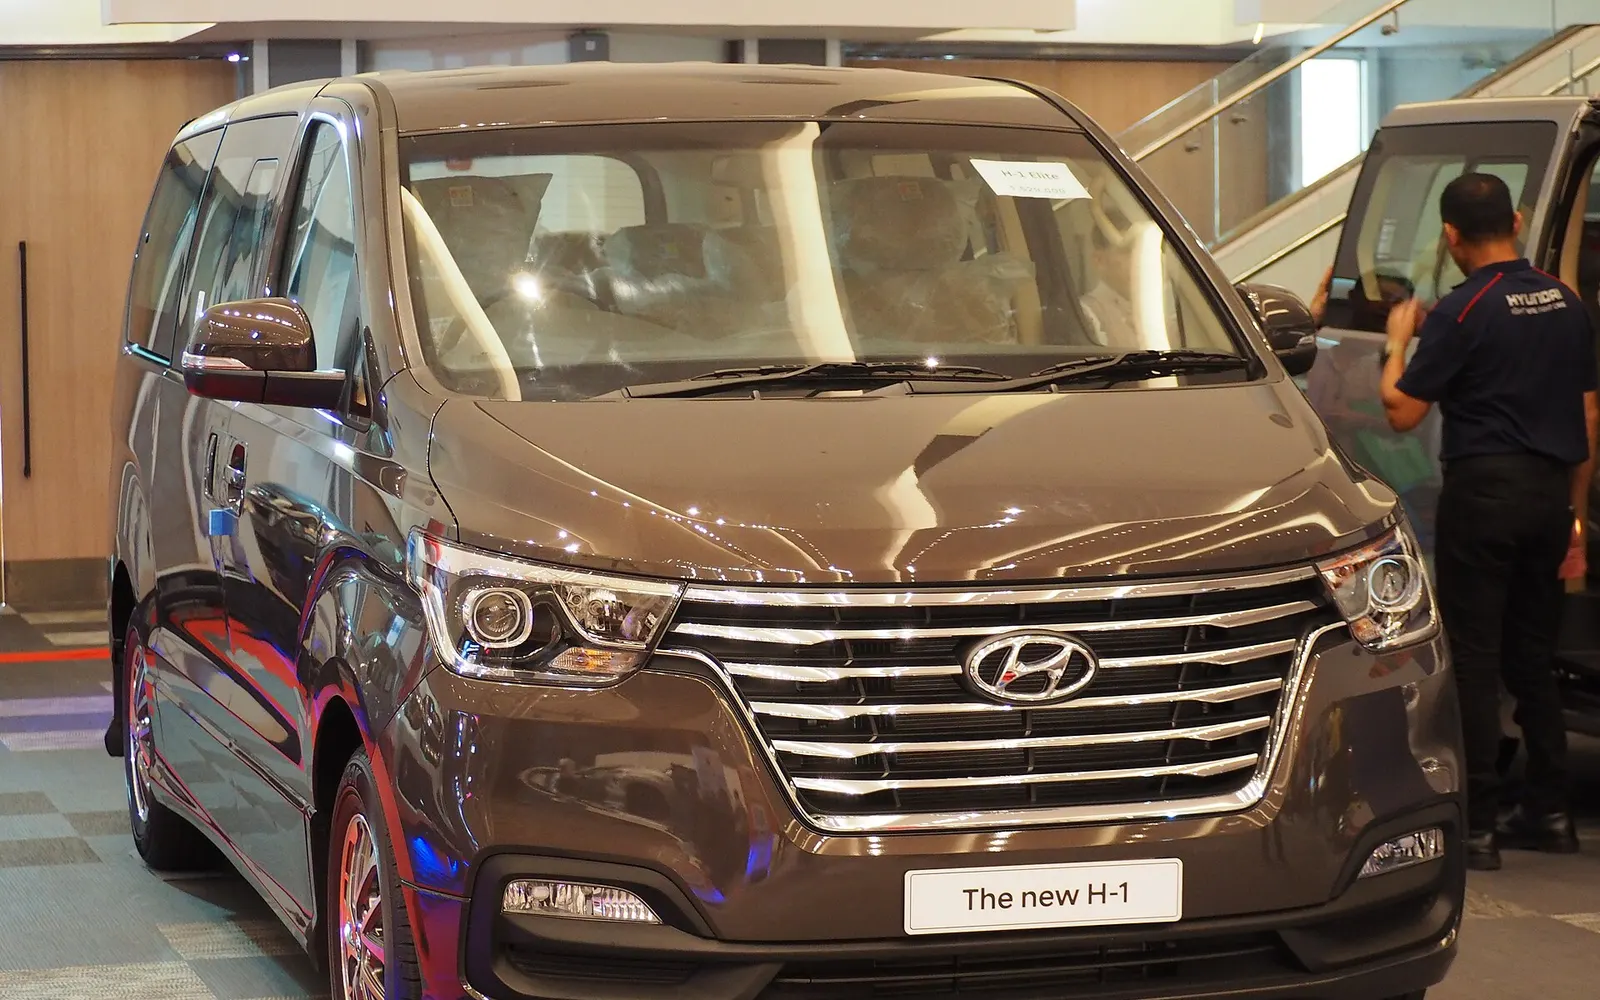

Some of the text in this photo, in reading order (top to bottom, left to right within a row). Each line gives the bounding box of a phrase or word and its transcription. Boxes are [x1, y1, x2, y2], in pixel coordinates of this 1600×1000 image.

[1001, 169, 1060, 180] H-1 Elite
[1505, 288, 1563, 307] HYUNDAI
[963, 881, 1129, 910] The new H-1
